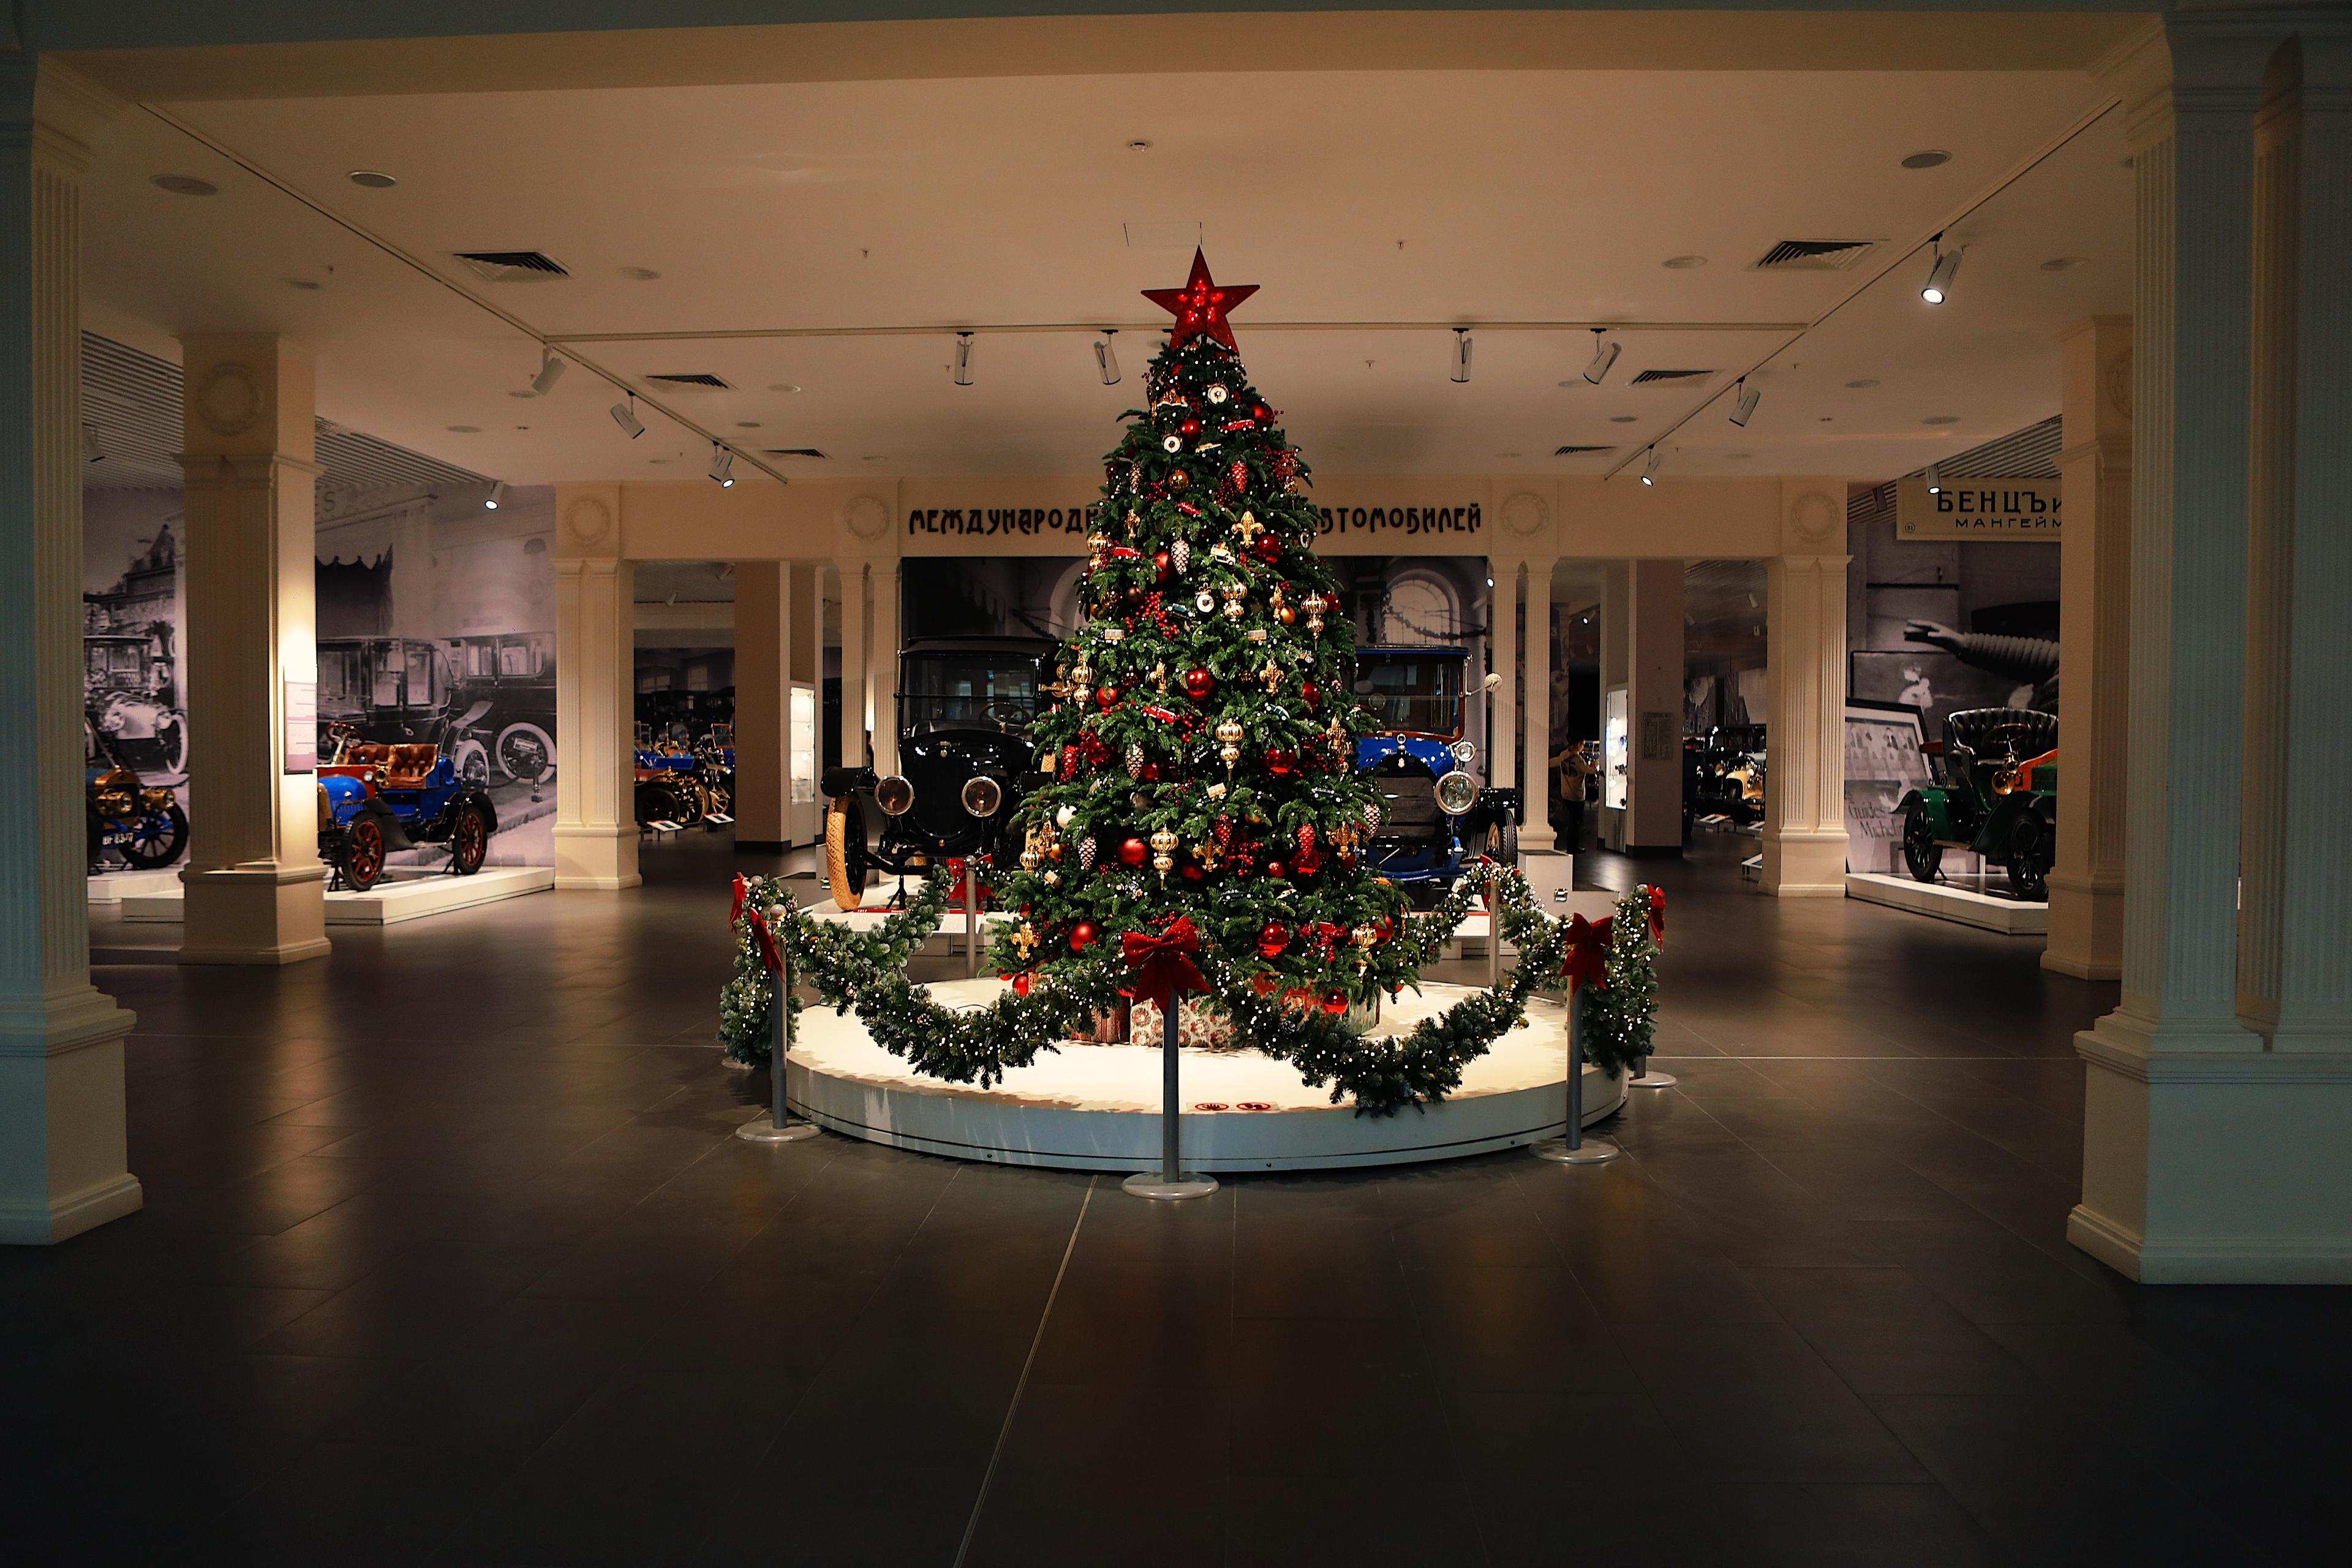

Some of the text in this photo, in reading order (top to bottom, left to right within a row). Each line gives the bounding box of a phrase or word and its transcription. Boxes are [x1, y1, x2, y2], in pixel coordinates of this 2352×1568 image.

[910, 503, 1480, 535] МЕЖДУНАРОДН ВТОМОБИЛЕЙ
[1955, 516, 2062, 528] МАНГЕЙМ
